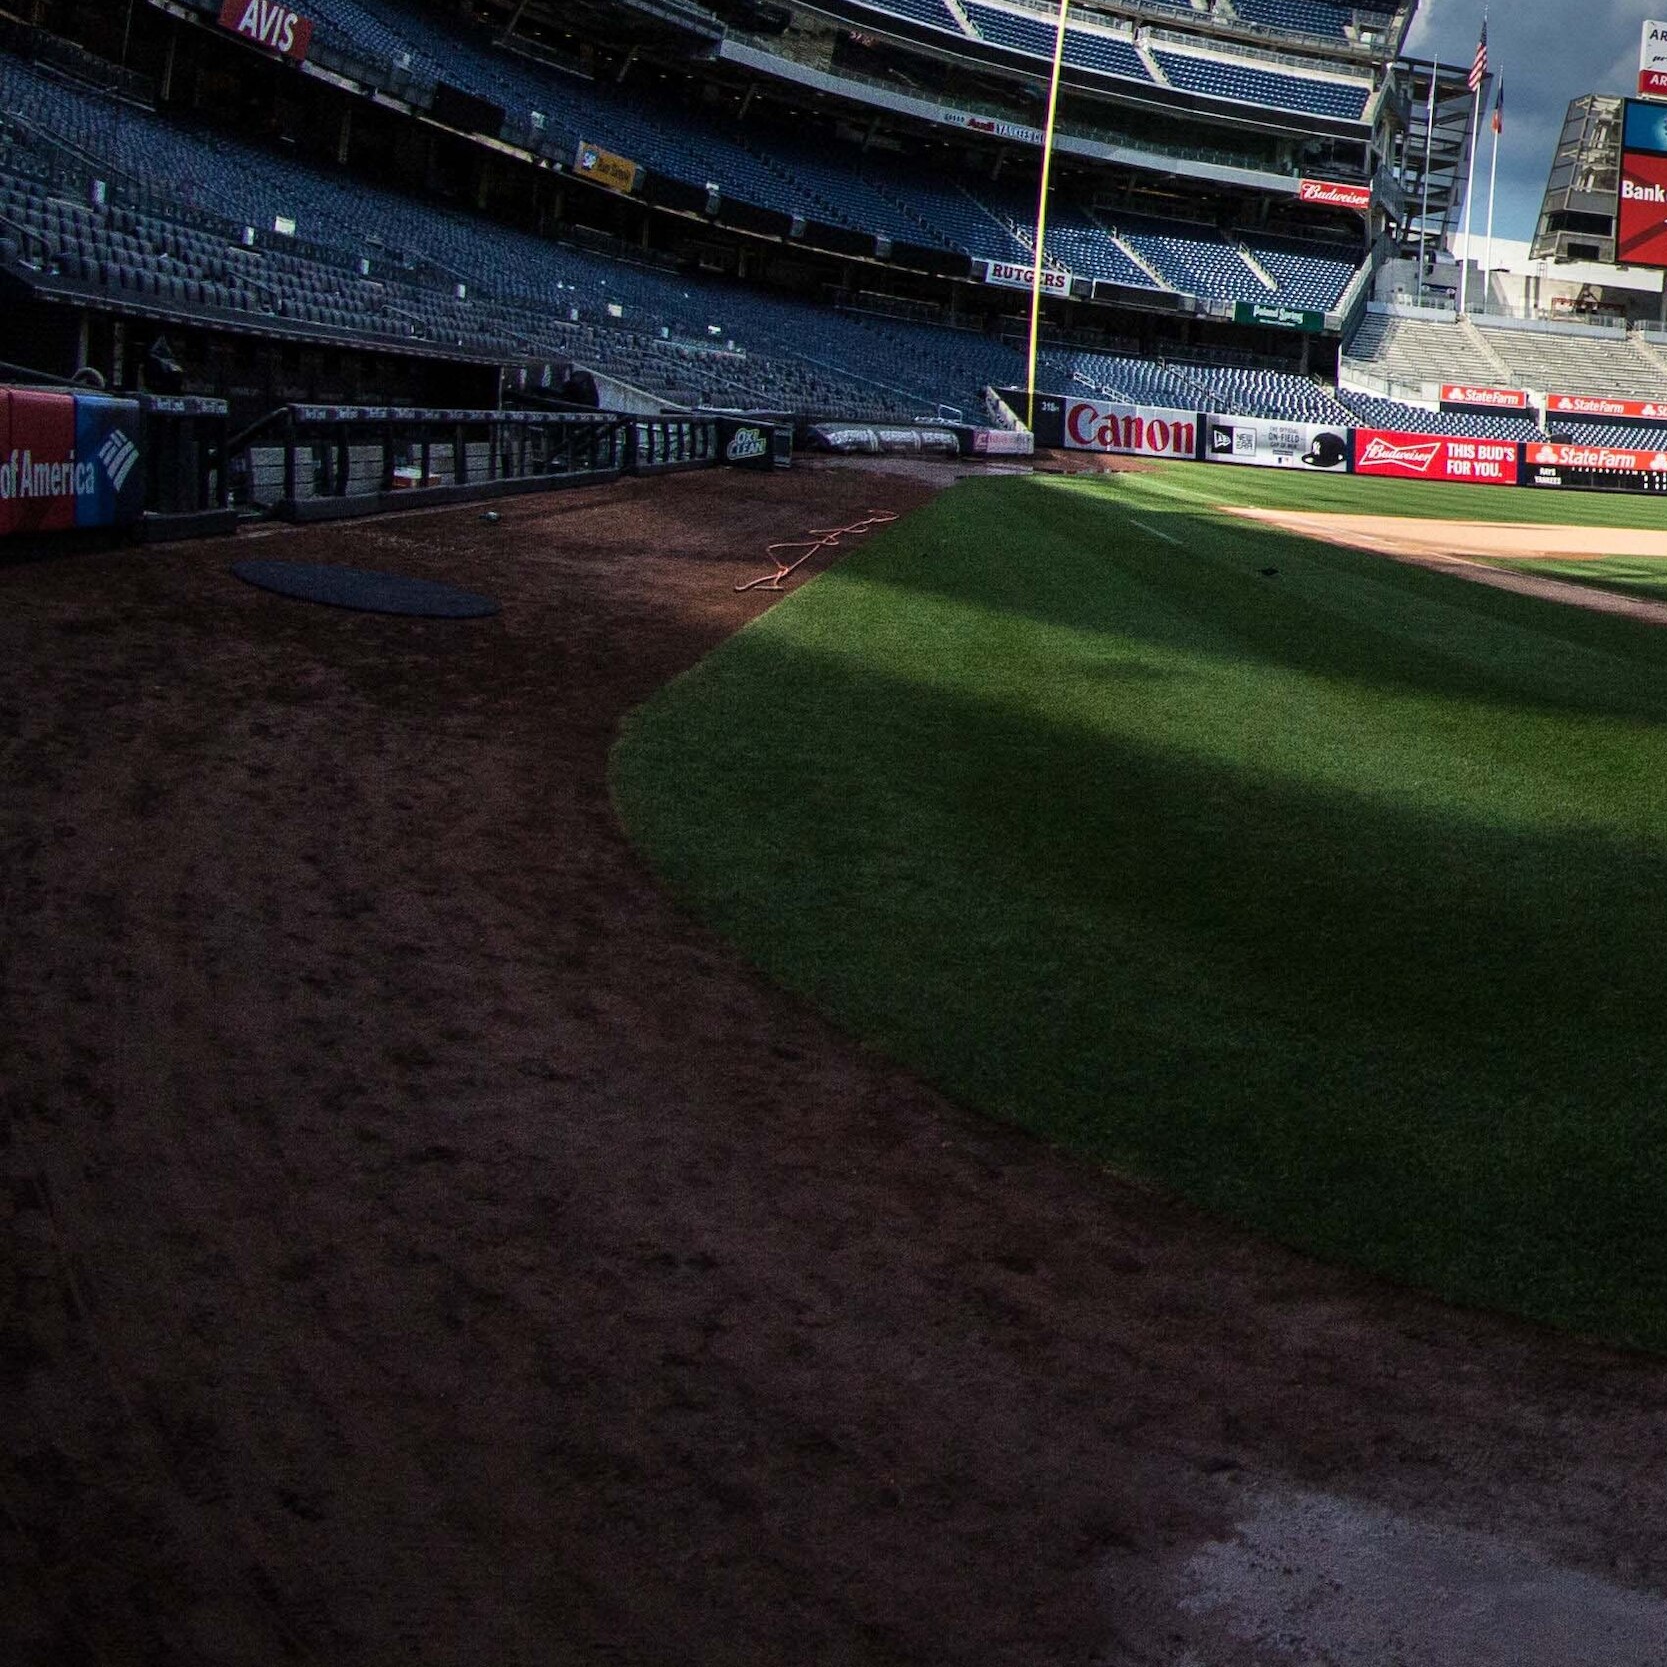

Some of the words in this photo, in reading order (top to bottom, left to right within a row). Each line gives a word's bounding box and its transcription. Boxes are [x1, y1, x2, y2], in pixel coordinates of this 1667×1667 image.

[1302, 183, 1369, 204] Budweiser
[1621, 180, 1666, 203] Bank
[1067, 403, 1195, 454] Canon
[1368, 443, 1436, 464] Budweiser
[1446, 443, 1475, 460] THIS
[1477, 444, 1516, 462] BUD'S
[20, 449, 95, 498] America
[1446, 461, 1471, 476] FOR
[1473, 462, 1503, 478] YOU.
